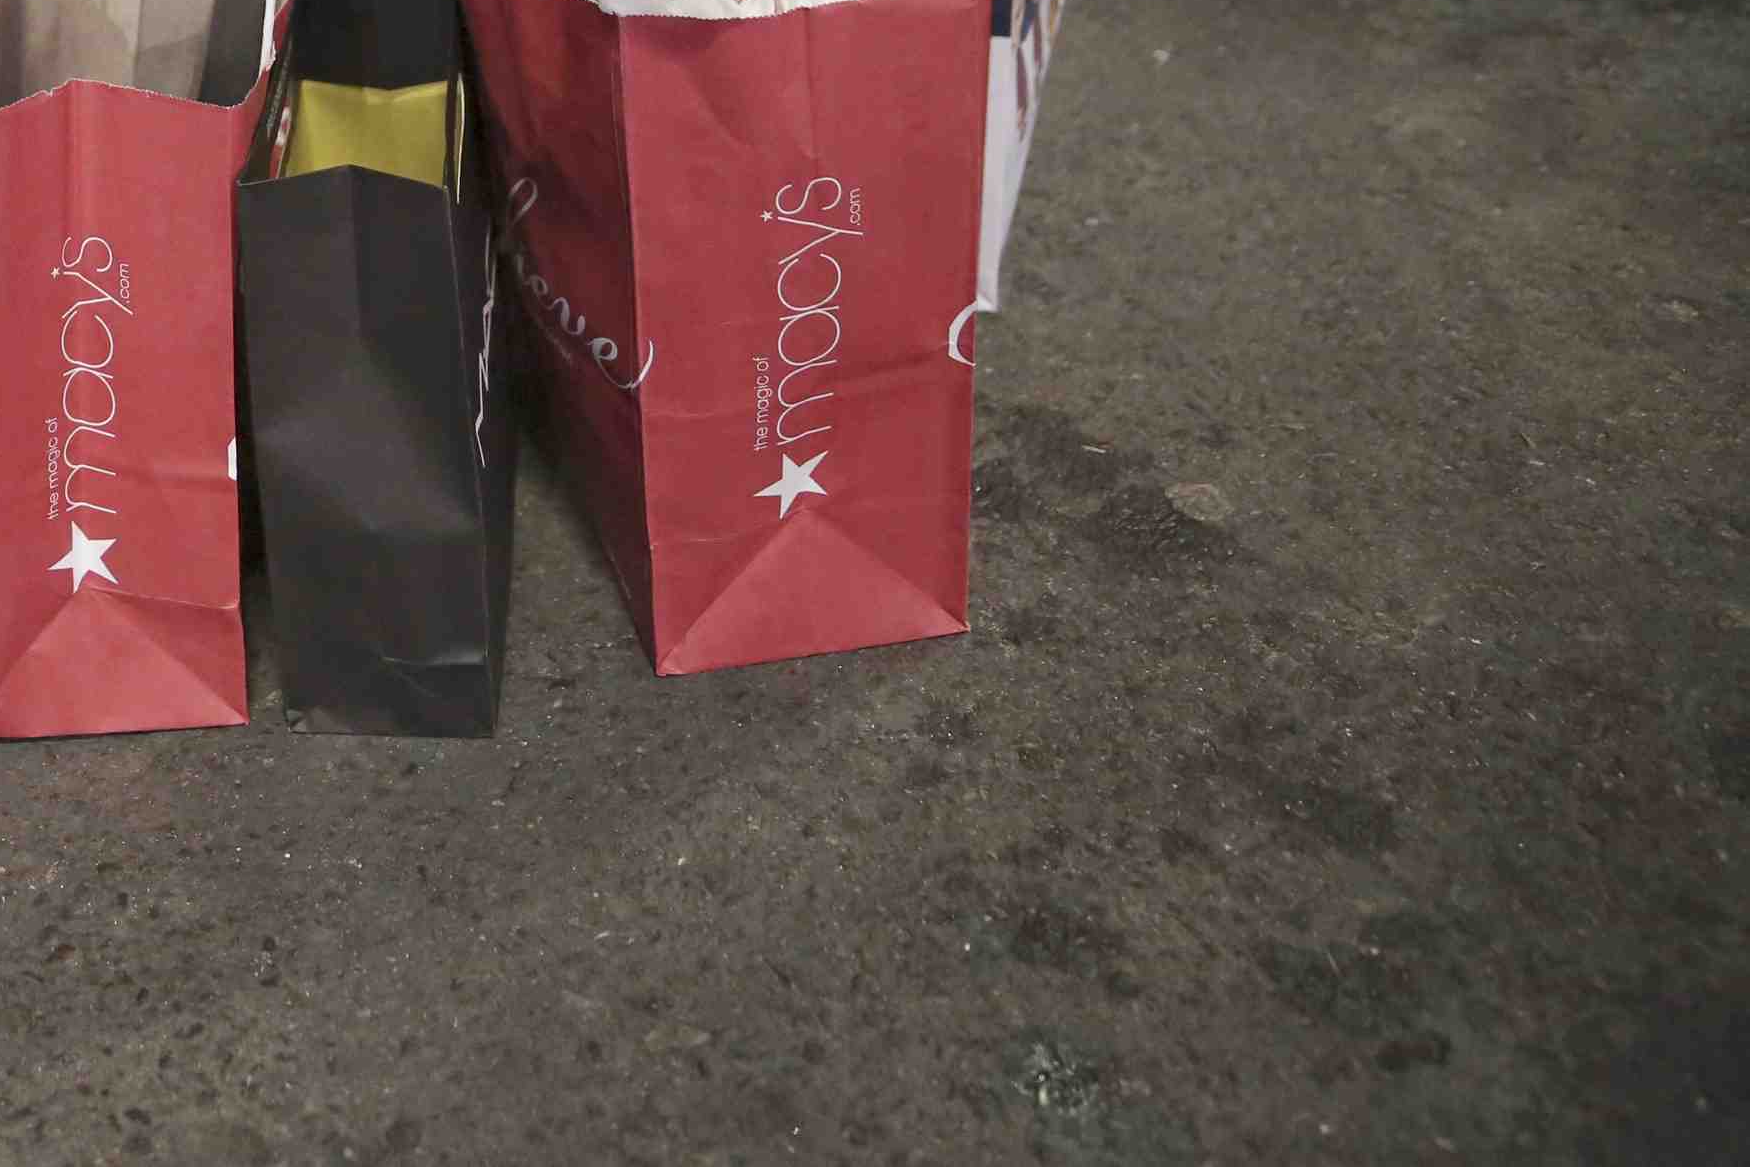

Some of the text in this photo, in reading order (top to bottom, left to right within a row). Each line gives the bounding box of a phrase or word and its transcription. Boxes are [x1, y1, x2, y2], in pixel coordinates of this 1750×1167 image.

[850, 187, 862, 227] .com
[119, 263, 130, 304] .com
[760, 176, 864, 446] macy's
[50, 236, 134, 514] macy's
[752, 357, 773, 451] the magic of
[45, 417, 61, 520] the magic of
